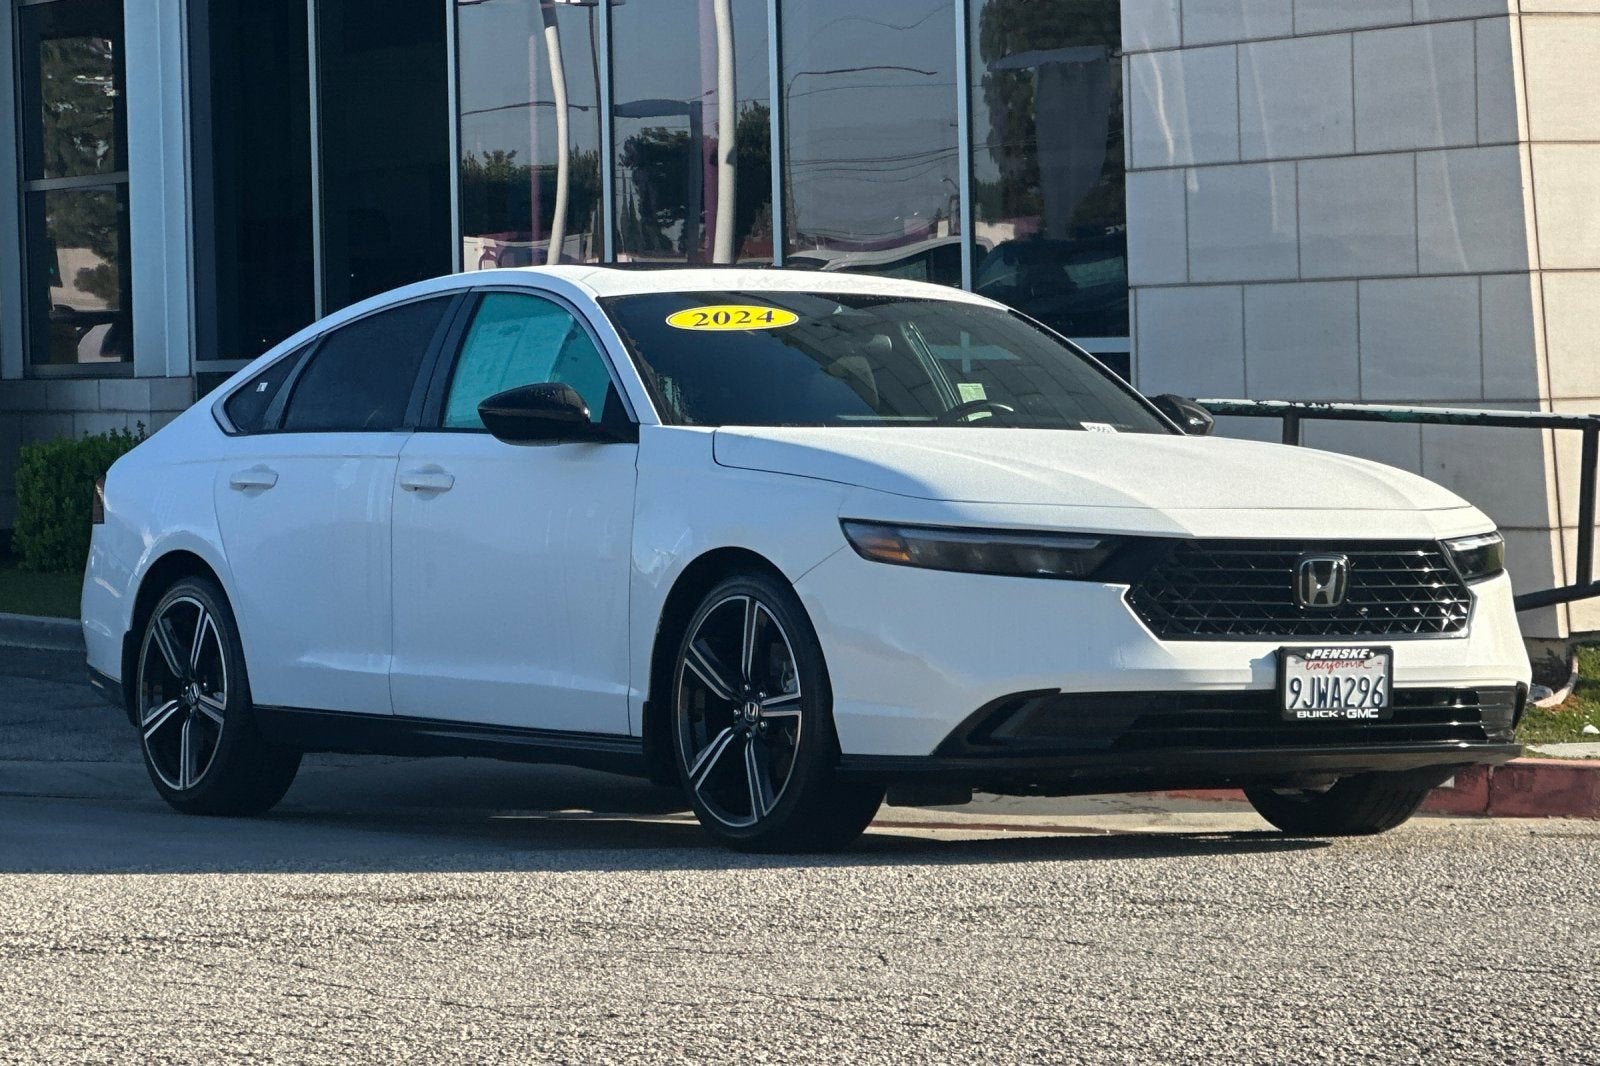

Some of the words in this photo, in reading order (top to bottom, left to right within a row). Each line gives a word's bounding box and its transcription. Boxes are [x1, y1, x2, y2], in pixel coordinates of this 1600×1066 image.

[692, 310, 775, 327] 2024
[1310, 648, 1370, 659] PENSKE
[1290, 676, 1385, 708] 9JWA296
[1296, 710, 1339, 718] BUICK
[1346, 708, 1379, 719] GMC
